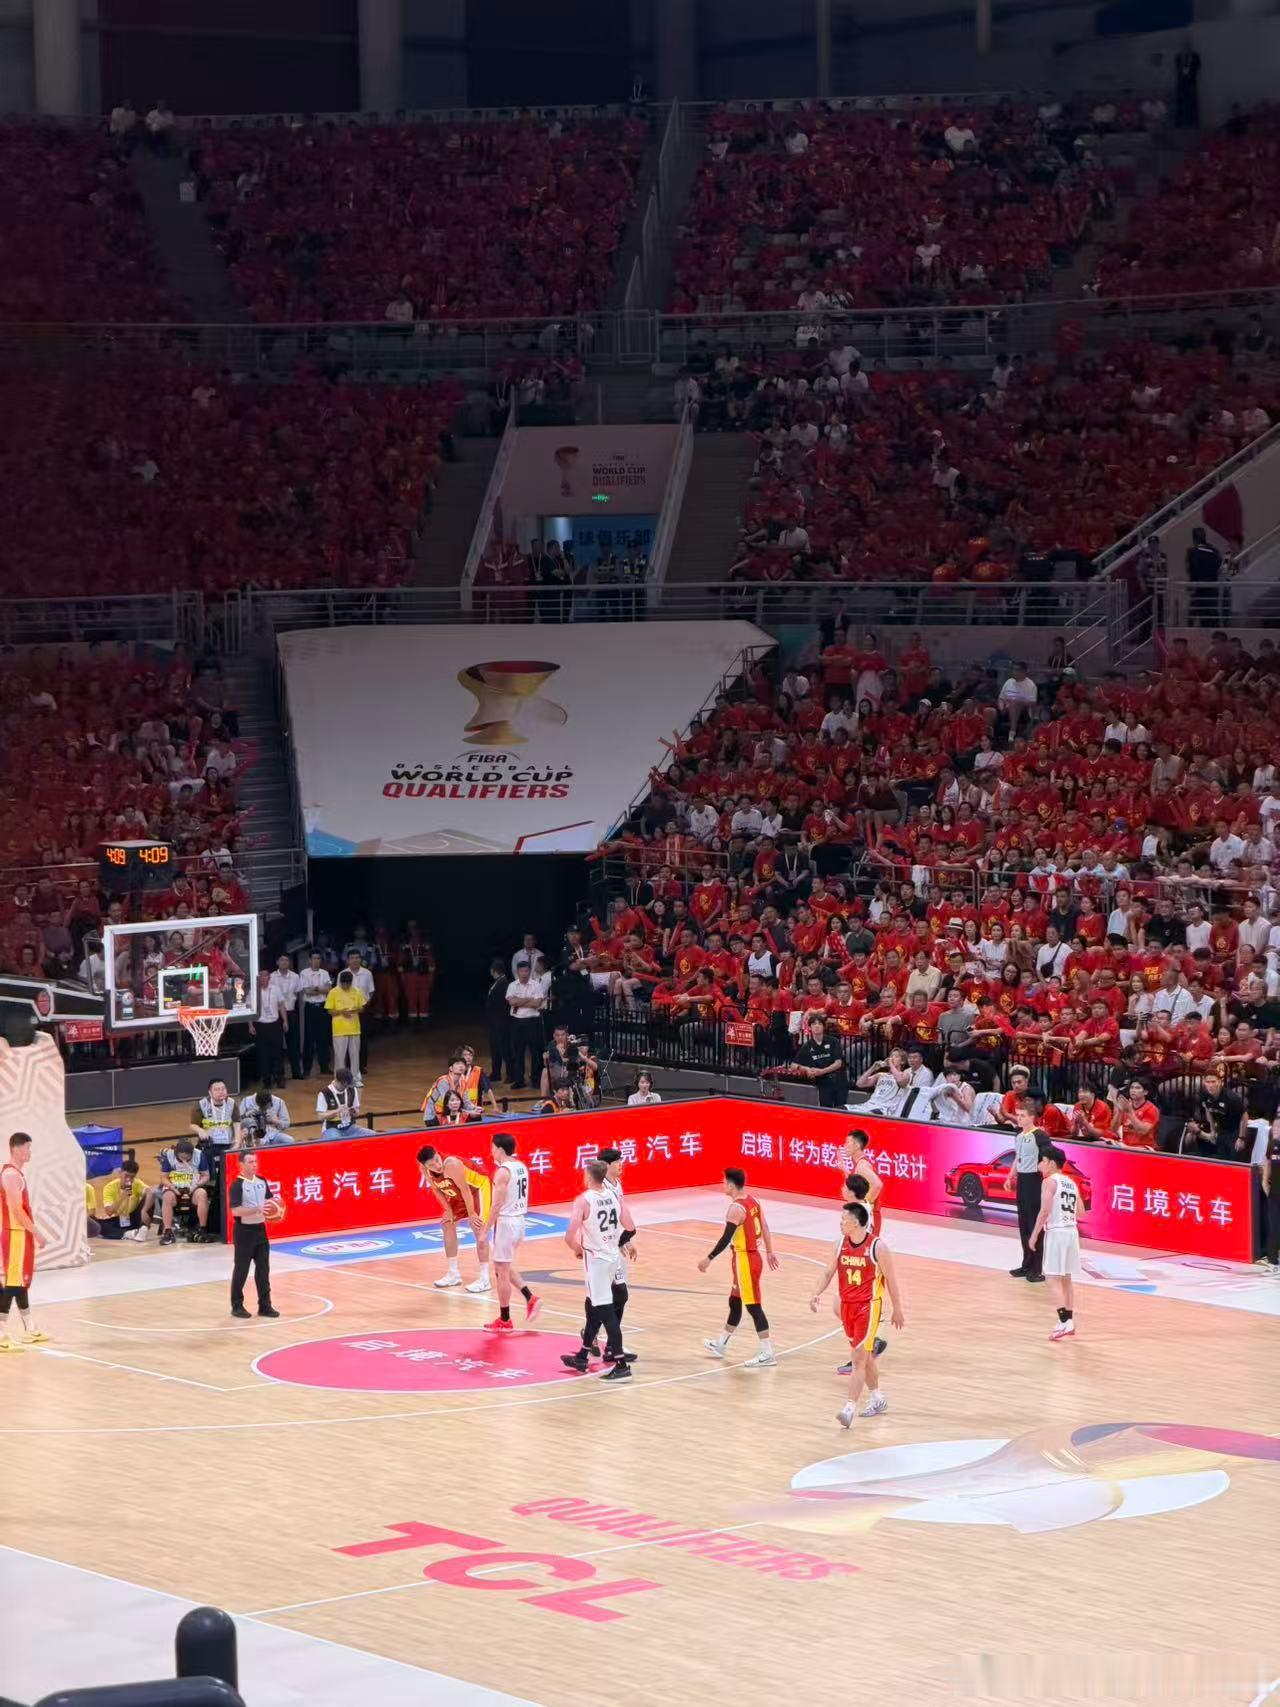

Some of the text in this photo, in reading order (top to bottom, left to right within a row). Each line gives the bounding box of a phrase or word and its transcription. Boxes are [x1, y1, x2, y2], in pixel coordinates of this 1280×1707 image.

[592, 466, 647, 475] WORLD CUP
[395, 763, 573, 771] BASKETBALL
[466, 754, 508, 763] FIBA
[390, 769, 574, 783] WORLD CUP
[382, 782, 570, 799] QUALIFIERS
[106, 847, 126, 865] 4:09
[139, 846, 169, 864] 4:09
[1060, 1191, 1077, 1214] 33
[1111, 1184, 1234, 1226] 启境汽车
[597, 1208, 619, 1233] 24
[840, 1255, 867, 1268] CHINA
[846, 1268, 862, 1286] 14
[511, 1496, 863, 1582] QUALIFIERS
[331, 1520, 667, 1623] TCL
